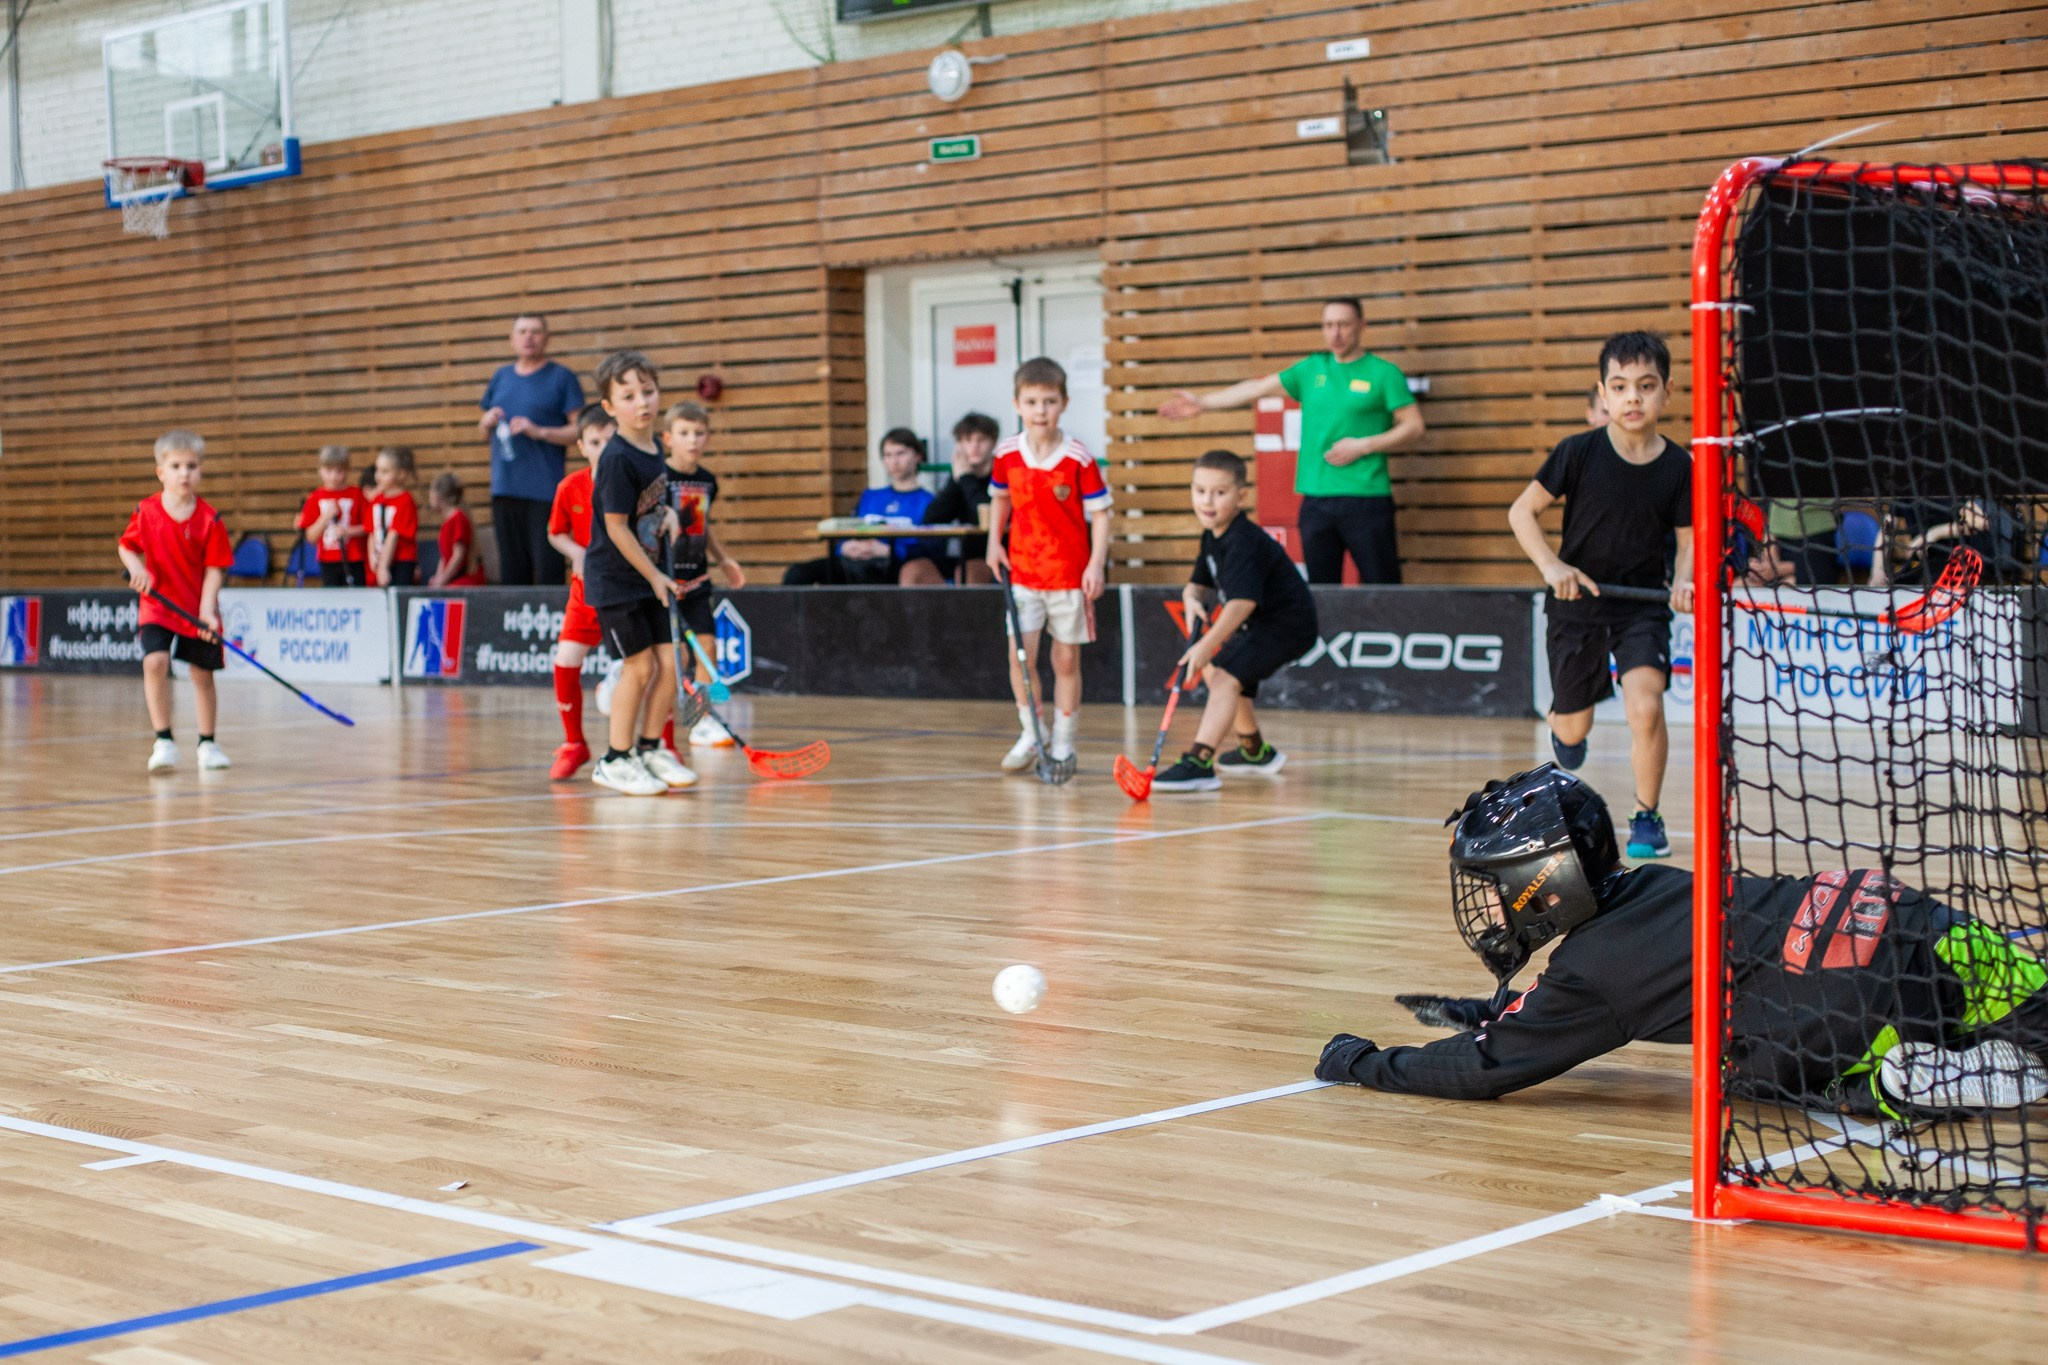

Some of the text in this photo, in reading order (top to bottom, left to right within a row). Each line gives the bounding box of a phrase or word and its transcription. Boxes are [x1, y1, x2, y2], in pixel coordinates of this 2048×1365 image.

[266, 607, 362, 633] МИНСПОРТ
[49, 633, 146, 660] #russiafloorb
[279, 638, 350, 663] РОССИИ
[1300, 631, 1504, 672] XDOG
[1775, 663, 1927, 699] РОССИИ
